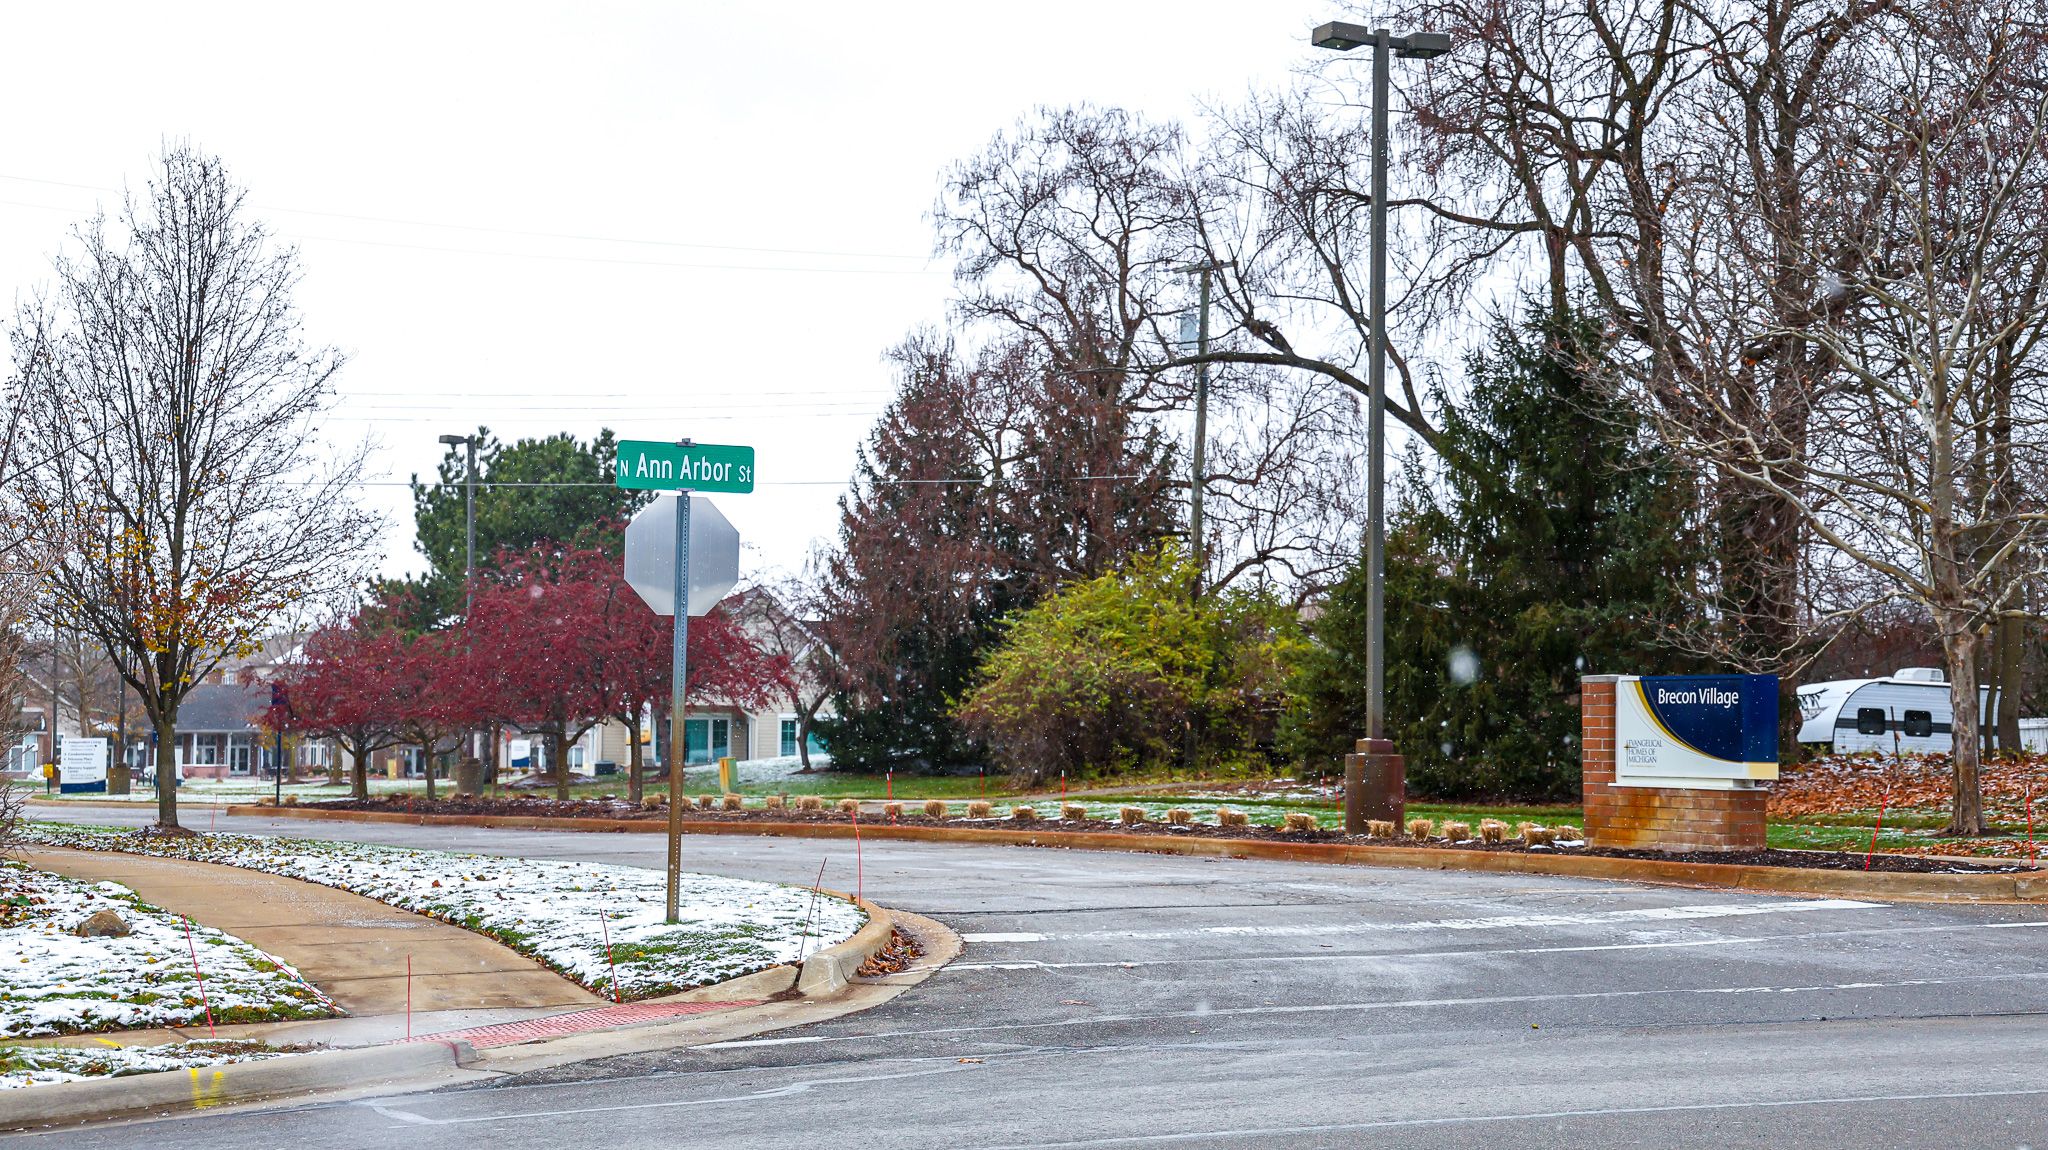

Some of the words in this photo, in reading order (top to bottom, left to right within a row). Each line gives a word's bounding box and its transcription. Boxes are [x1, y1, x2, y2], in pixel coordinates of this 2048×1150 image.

[620, 459, 629, 477] N
[636, 452, 673, 480] Ann
[680, 454, 732, 482] Arbor
[738, 465, 751, 483] St
[1658, 688, 1697, 705] Brecon
[1699, 687, 1739, 708] Village
[1628, 739, 1662, 748] EVANGELICAL
[1628, 748, 1648, 756] HOMES
[1648, 748, 1656, 756] OF
[1628, 756, 1657, 764] MICHIGAN
